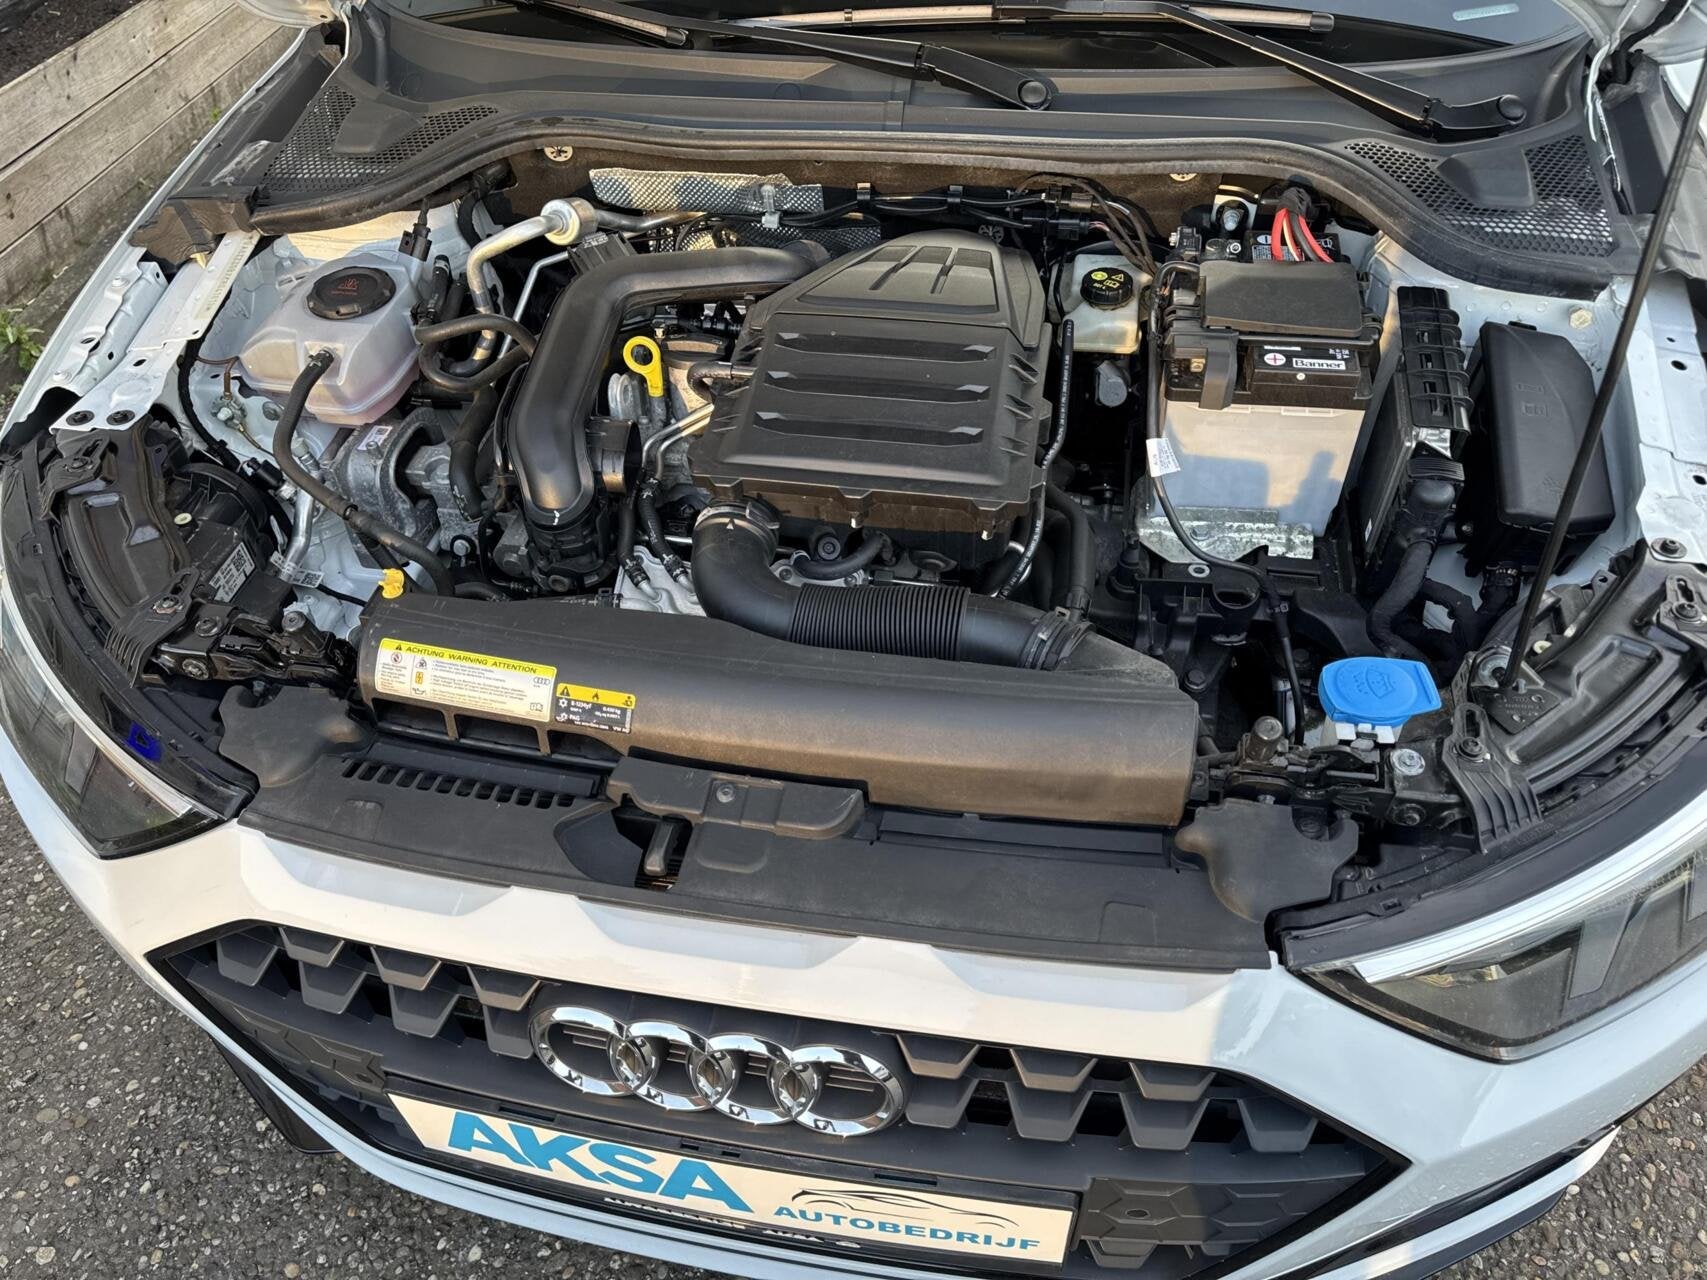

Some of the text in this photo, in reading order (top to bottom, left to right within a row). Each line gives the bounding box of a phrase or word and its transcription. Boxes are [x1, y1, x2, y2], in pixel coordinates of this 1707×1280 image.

[1294, 359, 1343, 369] Banner
[406, 646, 445, 658] ACHTUNG
[449, 654, 488, 666] WARNING
[492, 661, 537, 674] ATTENTION
[448, 1111, 755, 1213] AKSA
[774, 1206, 1041, 1250] AUTOBEDRIJF
